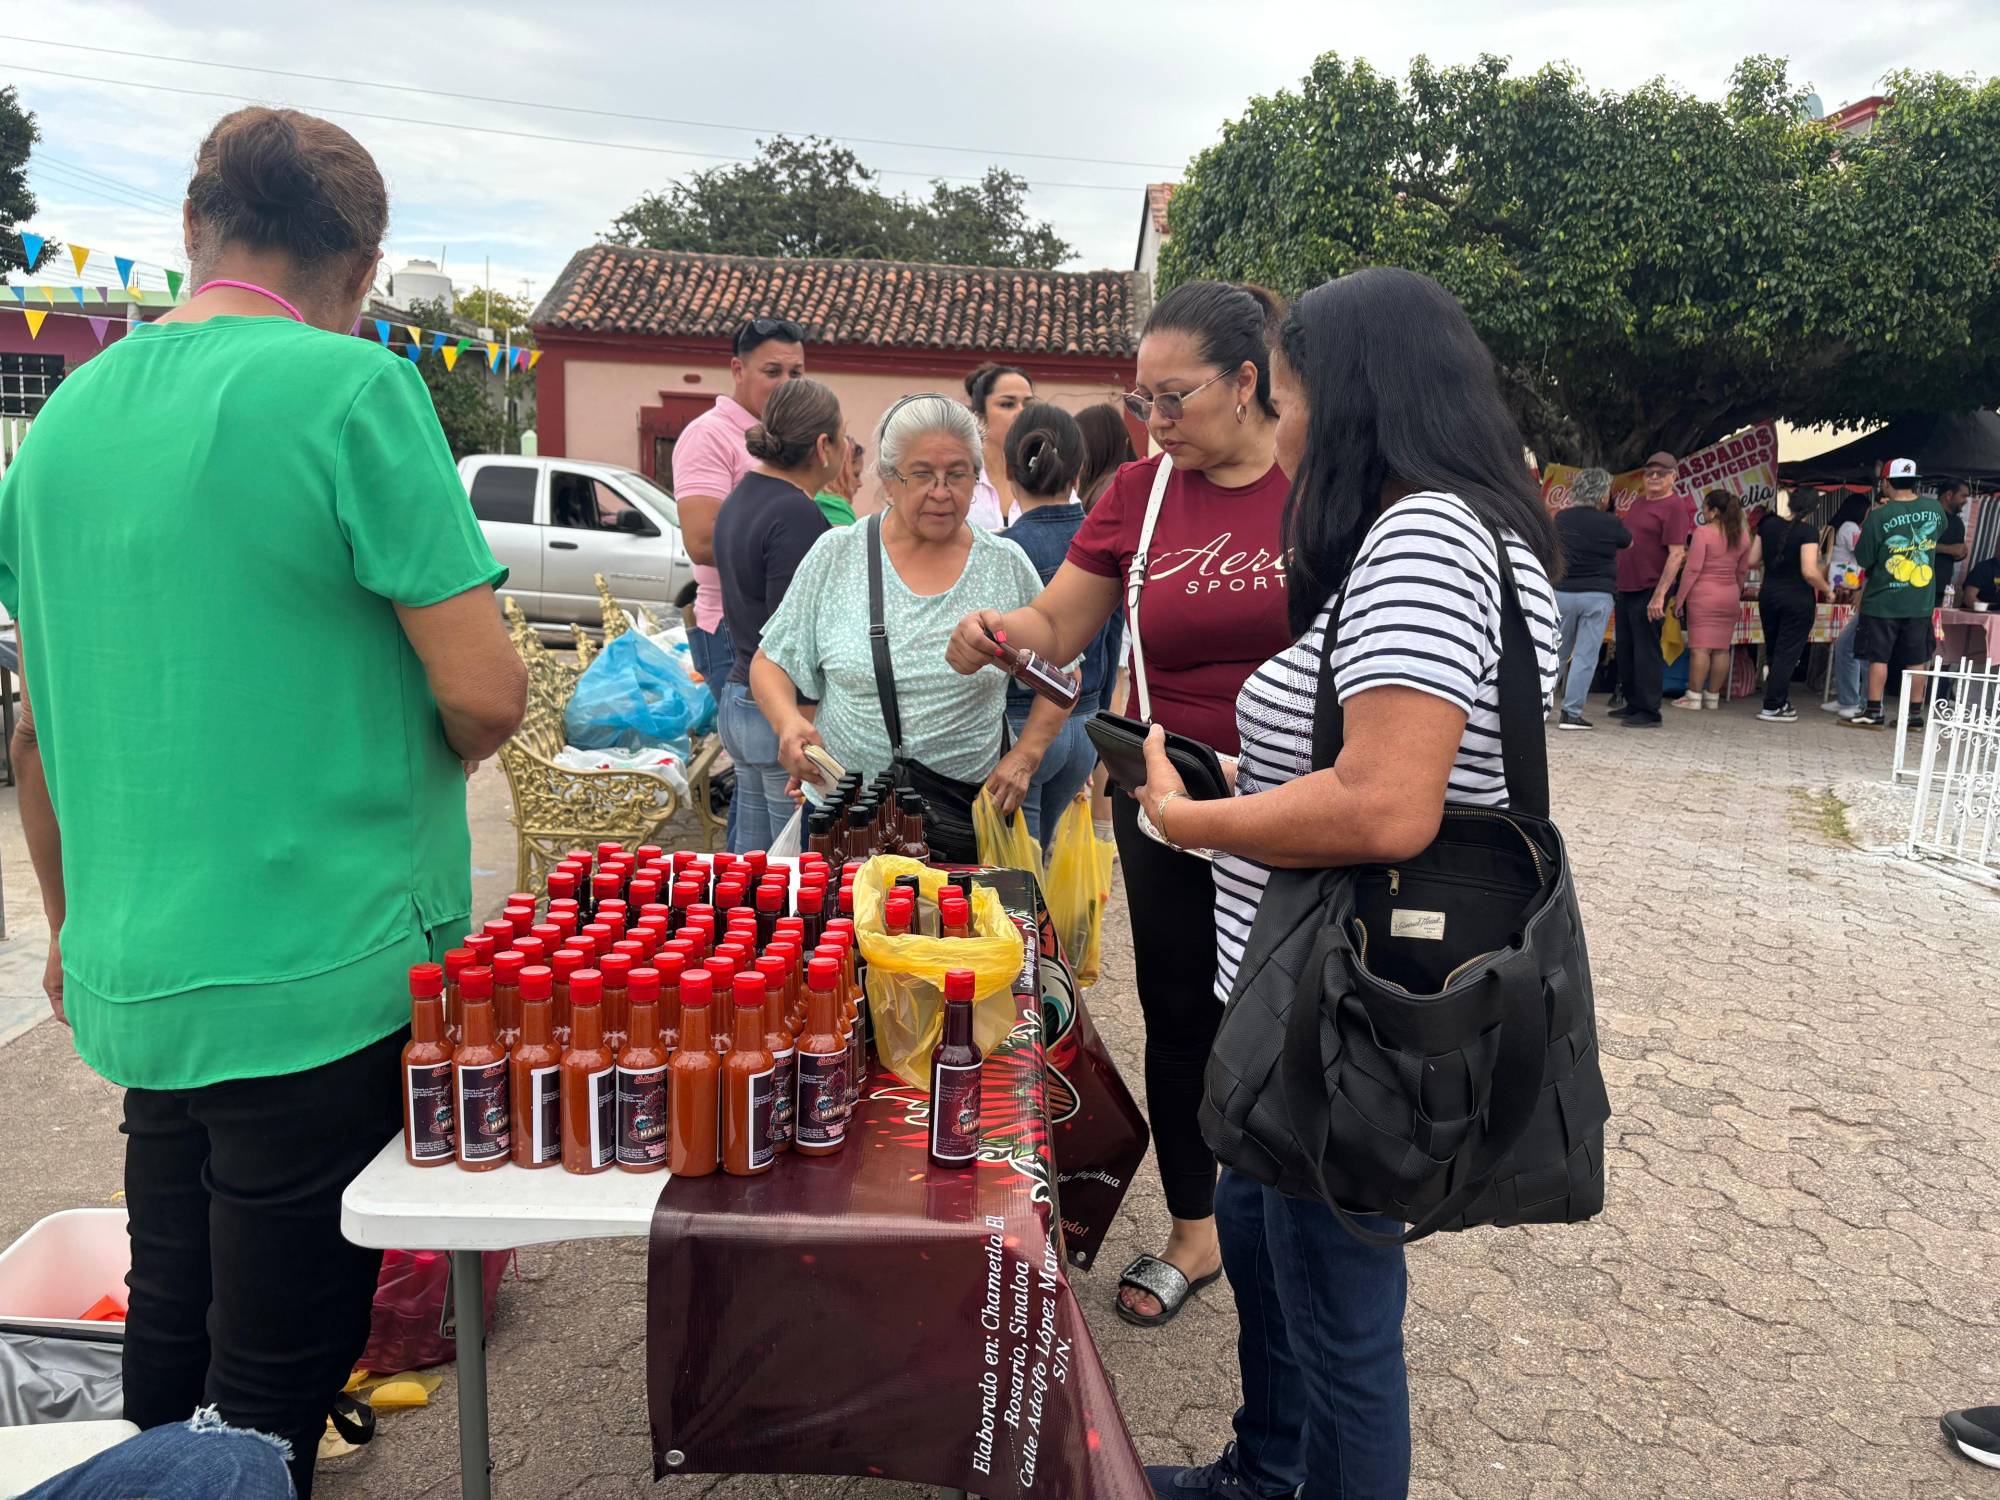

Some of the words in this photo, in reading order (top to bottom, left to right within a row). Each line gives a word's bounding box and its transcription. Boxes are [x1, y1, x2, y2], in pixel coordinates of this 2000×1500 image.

[1676, 481, 1688, 495] Y
[1691, 448, 1771, 488] CEVICHES
[1677, 427, 1772, 480] ASPADOS
[1061, 1218, 1090, 1237] odo!
[981, 1234, 1003, 1331] Chametla
[1038, 1235, 1058, 1294] Mate
[1009, 1261, 1029, 1338] Sinaloa
[1035, 1297, 1057, 1358] López
[985, 1335, 1000, 1366] en:
[1053, 1337, 1073, 1385] S/N.
[1004, 1343, 1029, 1430] Rosario,
[1027, 1361, 1048, 1436] Adolfo
[973, 1372, 998, 1476] Elaborado
[1019, 1435, 1039, 1488] Calle
